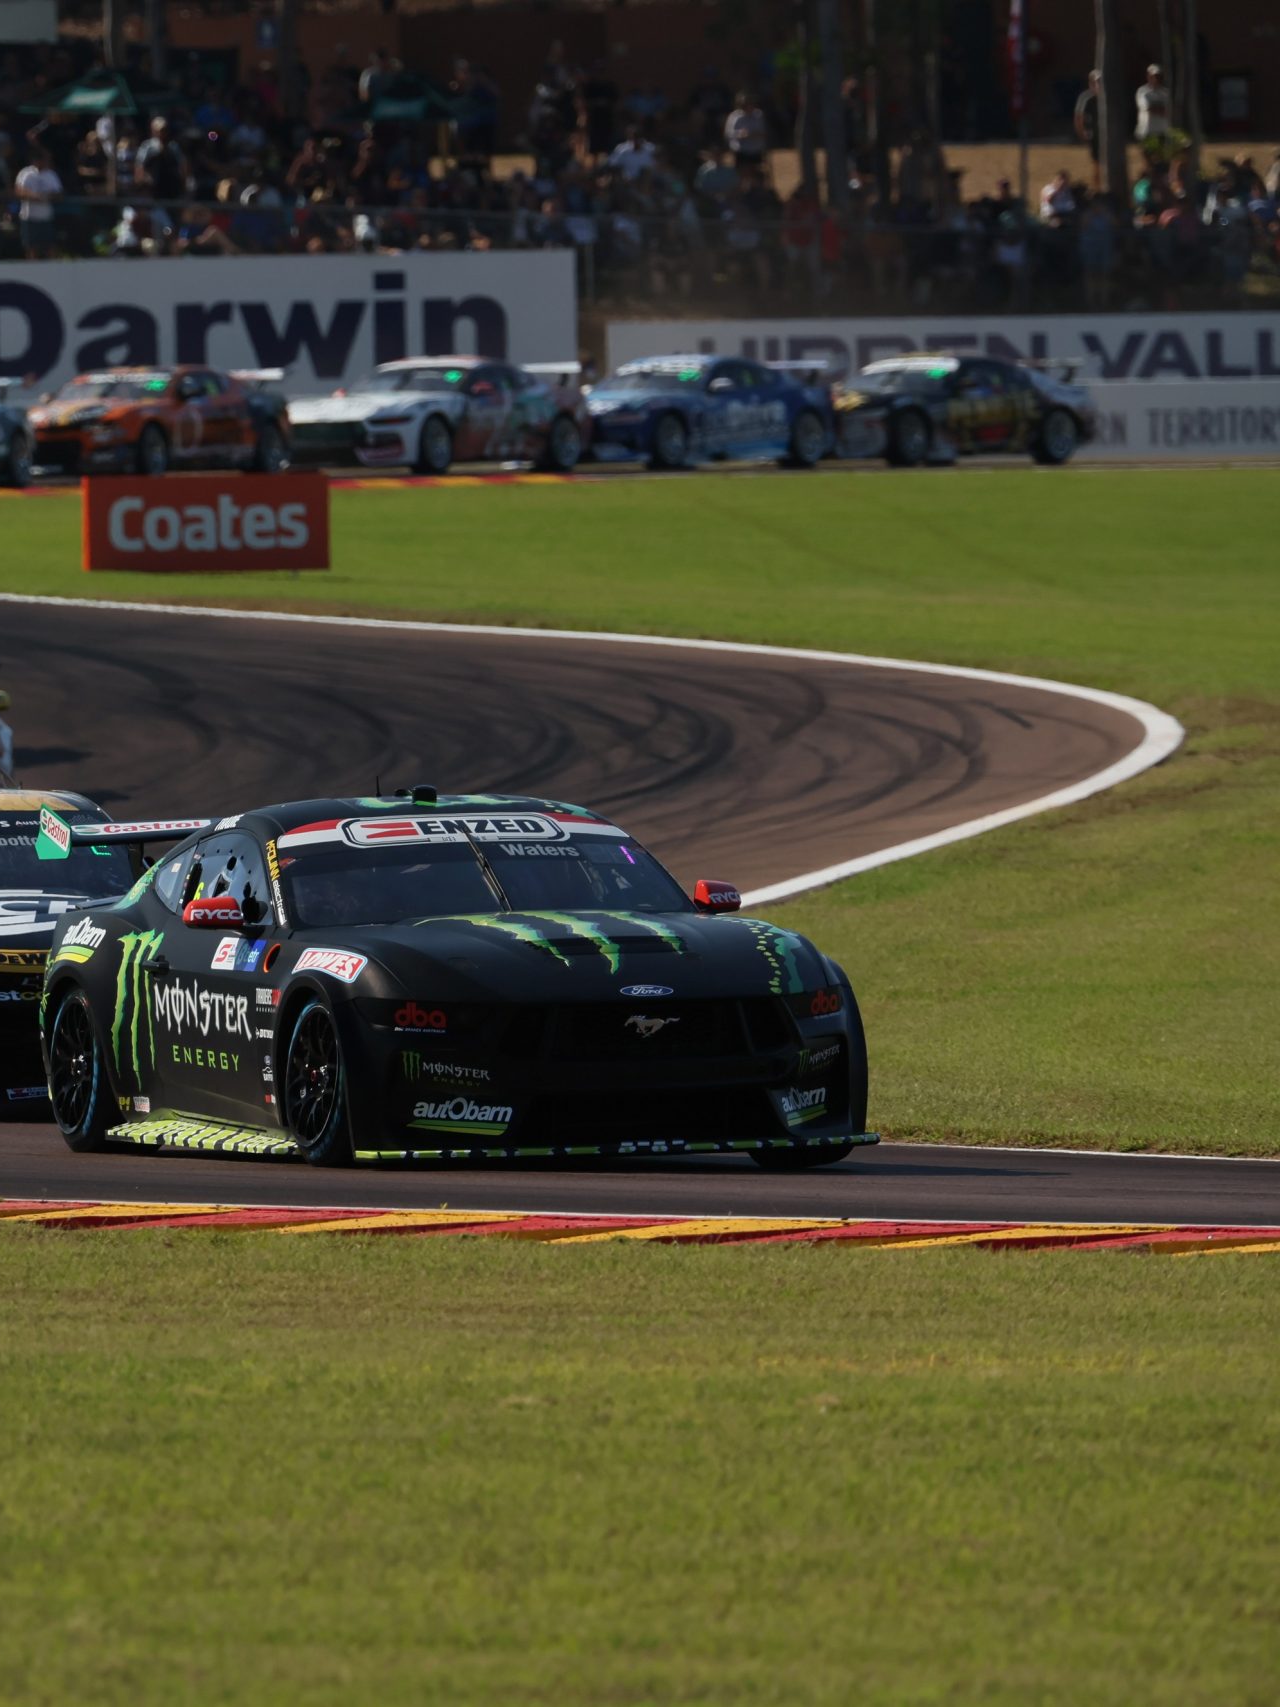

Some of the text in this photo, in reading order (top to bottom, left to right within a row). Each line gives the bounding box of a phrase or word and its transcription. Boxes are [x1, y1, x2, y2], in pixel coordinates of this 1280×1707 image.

[108, 495, 309, 551] Coates
[47, 816, 68, 849] Castrol
[103, 820, 203, 834] Castrol
[420, 819, 546, 835] ENZED
[500, 843, 580, 858] Waters
[190, 908, 243, 921] RYCO
[296, 951, 358, 979] LOWES
[630, 986, 664, 996] Ford
[811, 989, 839, 1016] dba
[394, 1001, 448, 1028] dba
[172, 1045, 239, 1072] ENERGY
[432, 1076, 482, 1088] ENERGY
